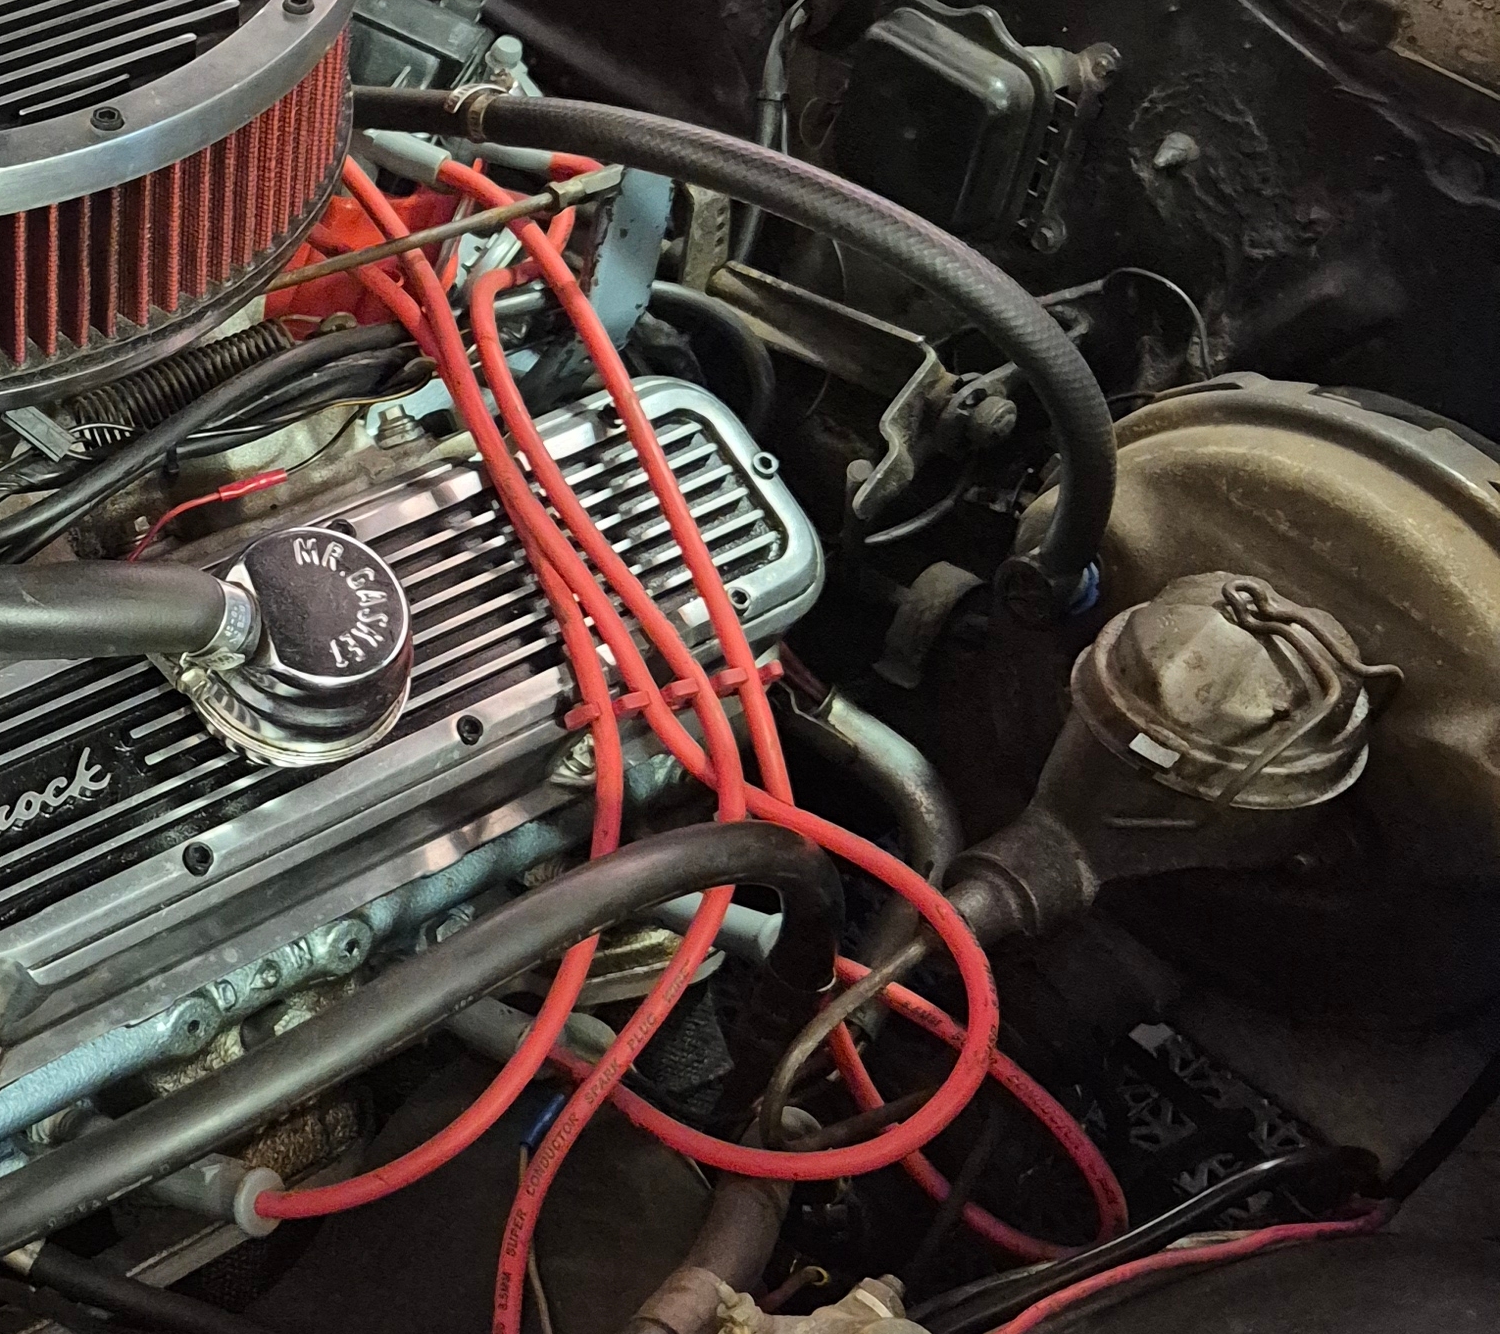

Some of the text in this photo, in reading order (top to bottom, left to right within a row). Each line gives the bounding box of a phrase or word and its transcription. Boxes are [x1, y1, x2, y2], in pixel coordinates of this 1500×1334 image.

[293, 537, 389, 668] MR. GASKET
[506, 1208, 527, 1257] SUPER
[525, 1111, 580, 1198] CONDUCTOR
[584, 1057, 623, 1106] SPARK
[626, 1012, 657, 1053] PLUG
